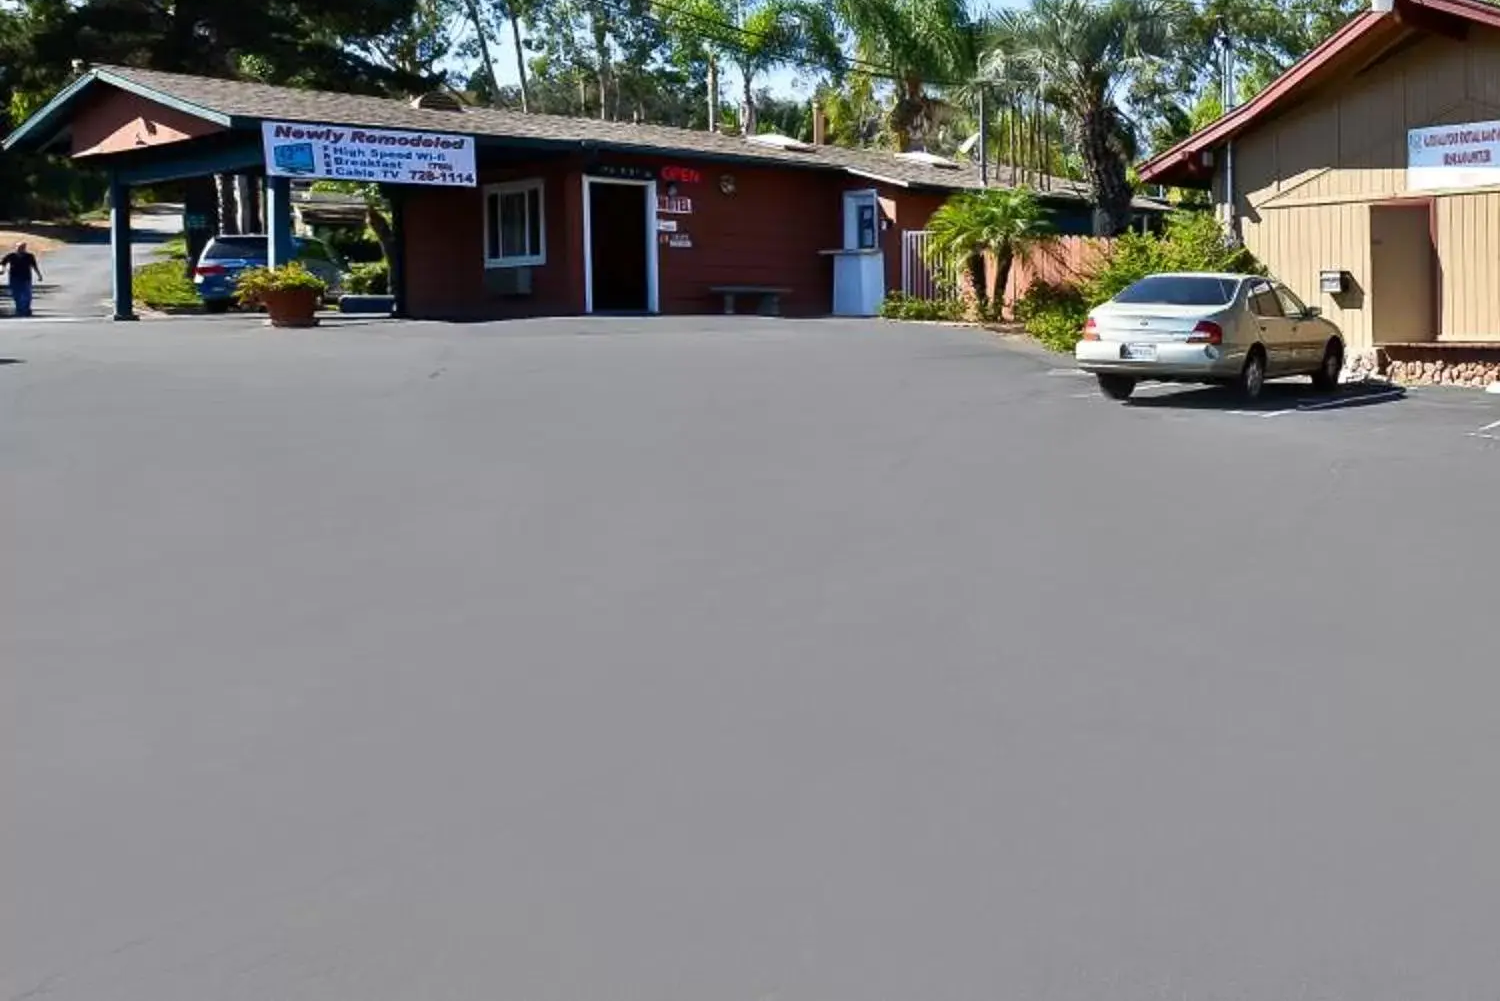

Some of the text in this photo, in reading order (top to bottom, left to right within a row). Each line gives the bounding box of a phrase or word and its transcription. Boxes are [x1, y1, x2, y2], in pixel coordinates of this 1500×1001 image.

[274, 125, 465, 150] Newly Remodeled
[334, 147, 366, 159] High
[370, 148, 413, 161] Speed
[334, 157, 403, 170] Breakfast
[335, 166, 400, 180] Cable TV
[408, 169, 475, 184] 728-1114
